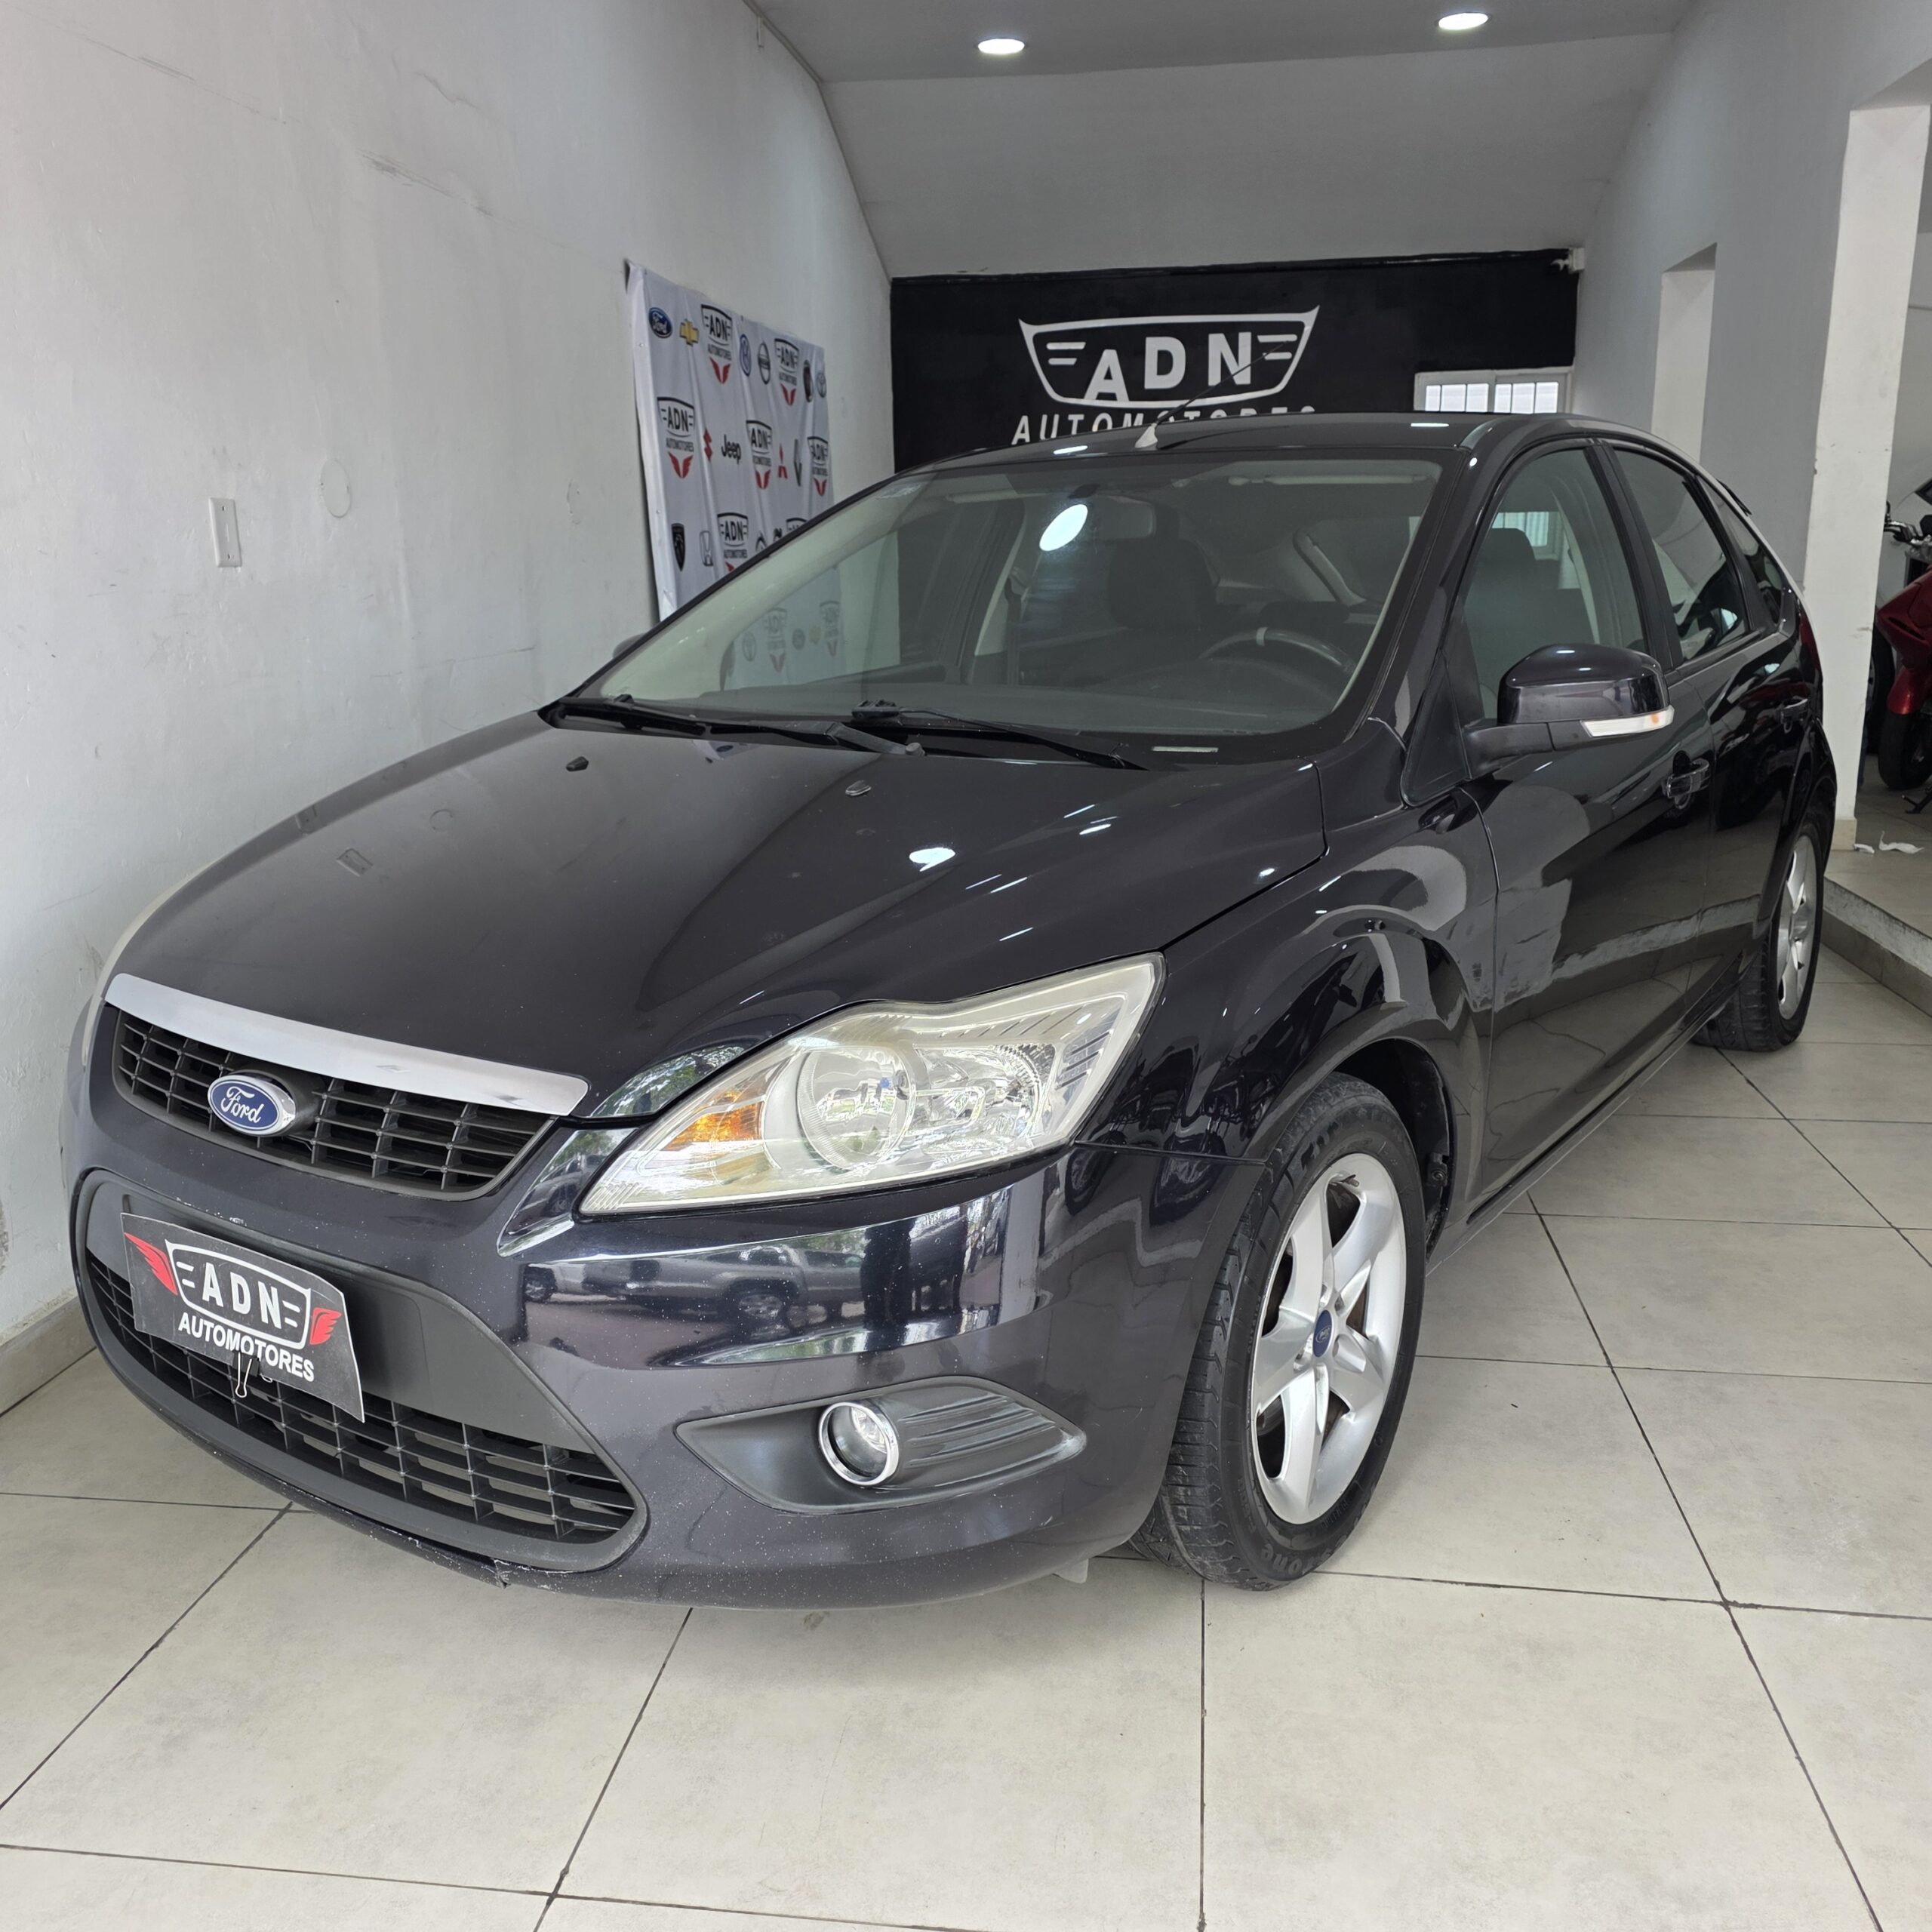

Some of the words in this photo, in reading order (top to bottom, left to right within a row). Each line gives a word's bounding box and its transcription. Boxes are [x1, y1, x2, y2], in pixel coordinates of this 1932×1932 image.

[709, 314, 728, 341] ADN
[780, 346, 796, 369] ADN
[1083, 331, 1252, 401] ADN
[667, 406, 689, 432] ADN
[721, 434, 742, 465] Jeep
[751, 428, 768, 450] ADN
[724, 521, 744, 542] ADN
[220, 1086, 265, 1124] Ford
[202, 1262, 282, 1330] ADN
[177, 1312, 315, 1383] AUTOMOTORES
